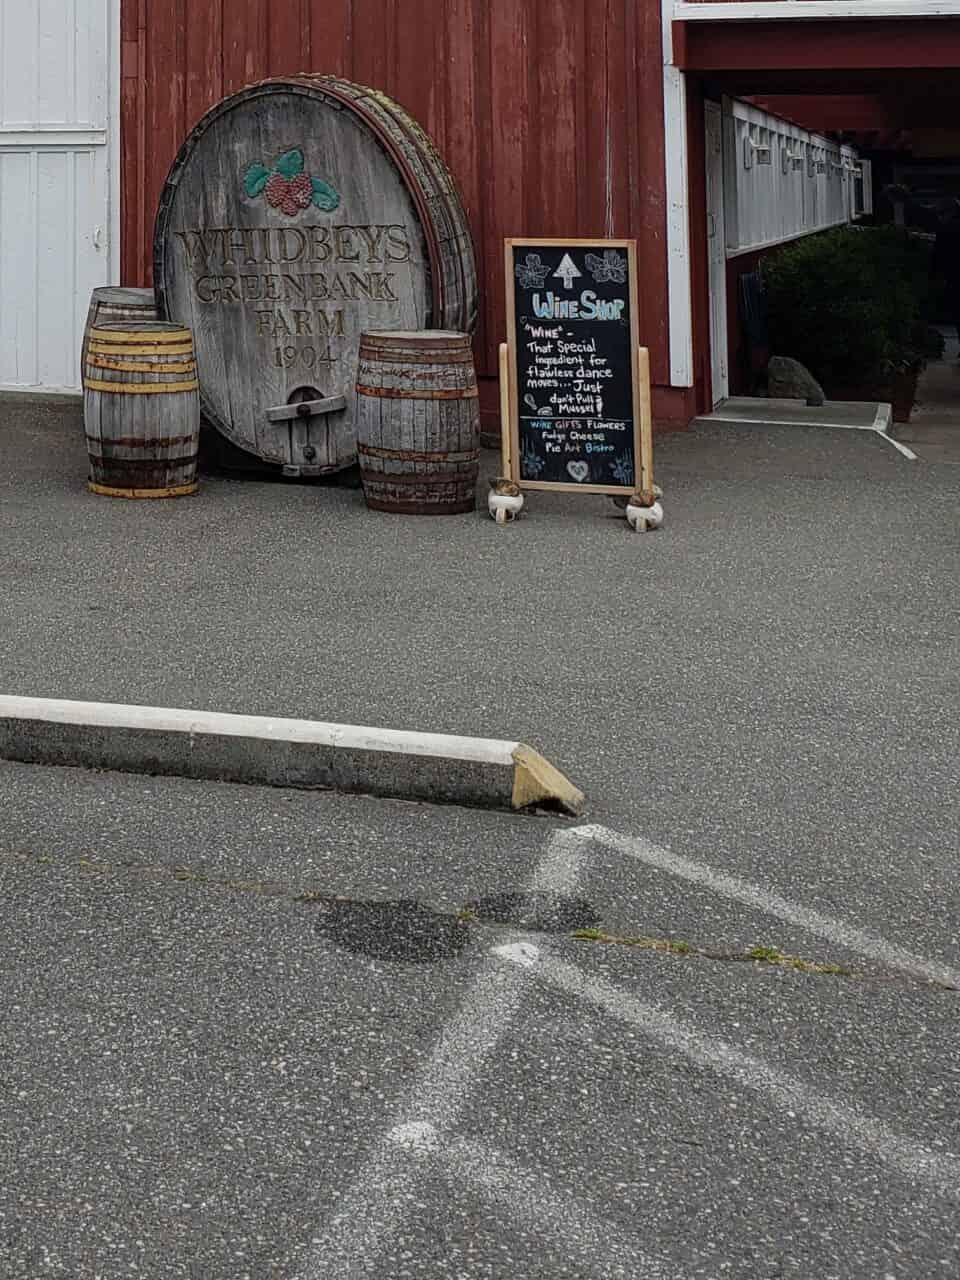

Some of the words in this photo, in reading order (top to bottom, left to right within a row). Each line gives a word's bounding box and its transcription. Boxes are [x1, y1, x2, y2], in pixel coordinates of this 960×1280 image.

[175, 225, 411, 265] WHIDBEYS
[194, 272, 398, 304] GREENBANK
[254, 308, 346, 337] FARM
[527, 341, 554, 353] That
[557, 338, 596, 354] Special
[273, 345, 338, 369] 1904
[589, 354, 607, 366] for
[526, 366, 573, 377] flawless
[575, 366, 613, 378] dance
[573, 380, 603, 393] Just
[550, 393, 575, 404] don't
[542, 430, 566, 443] Fudge
[569, 431, 605, 441] Cheese
[545, 442, 561, 453] Pie
[564, 442, 581, 453] Art
[585, 442, 615, 454] Bistro
